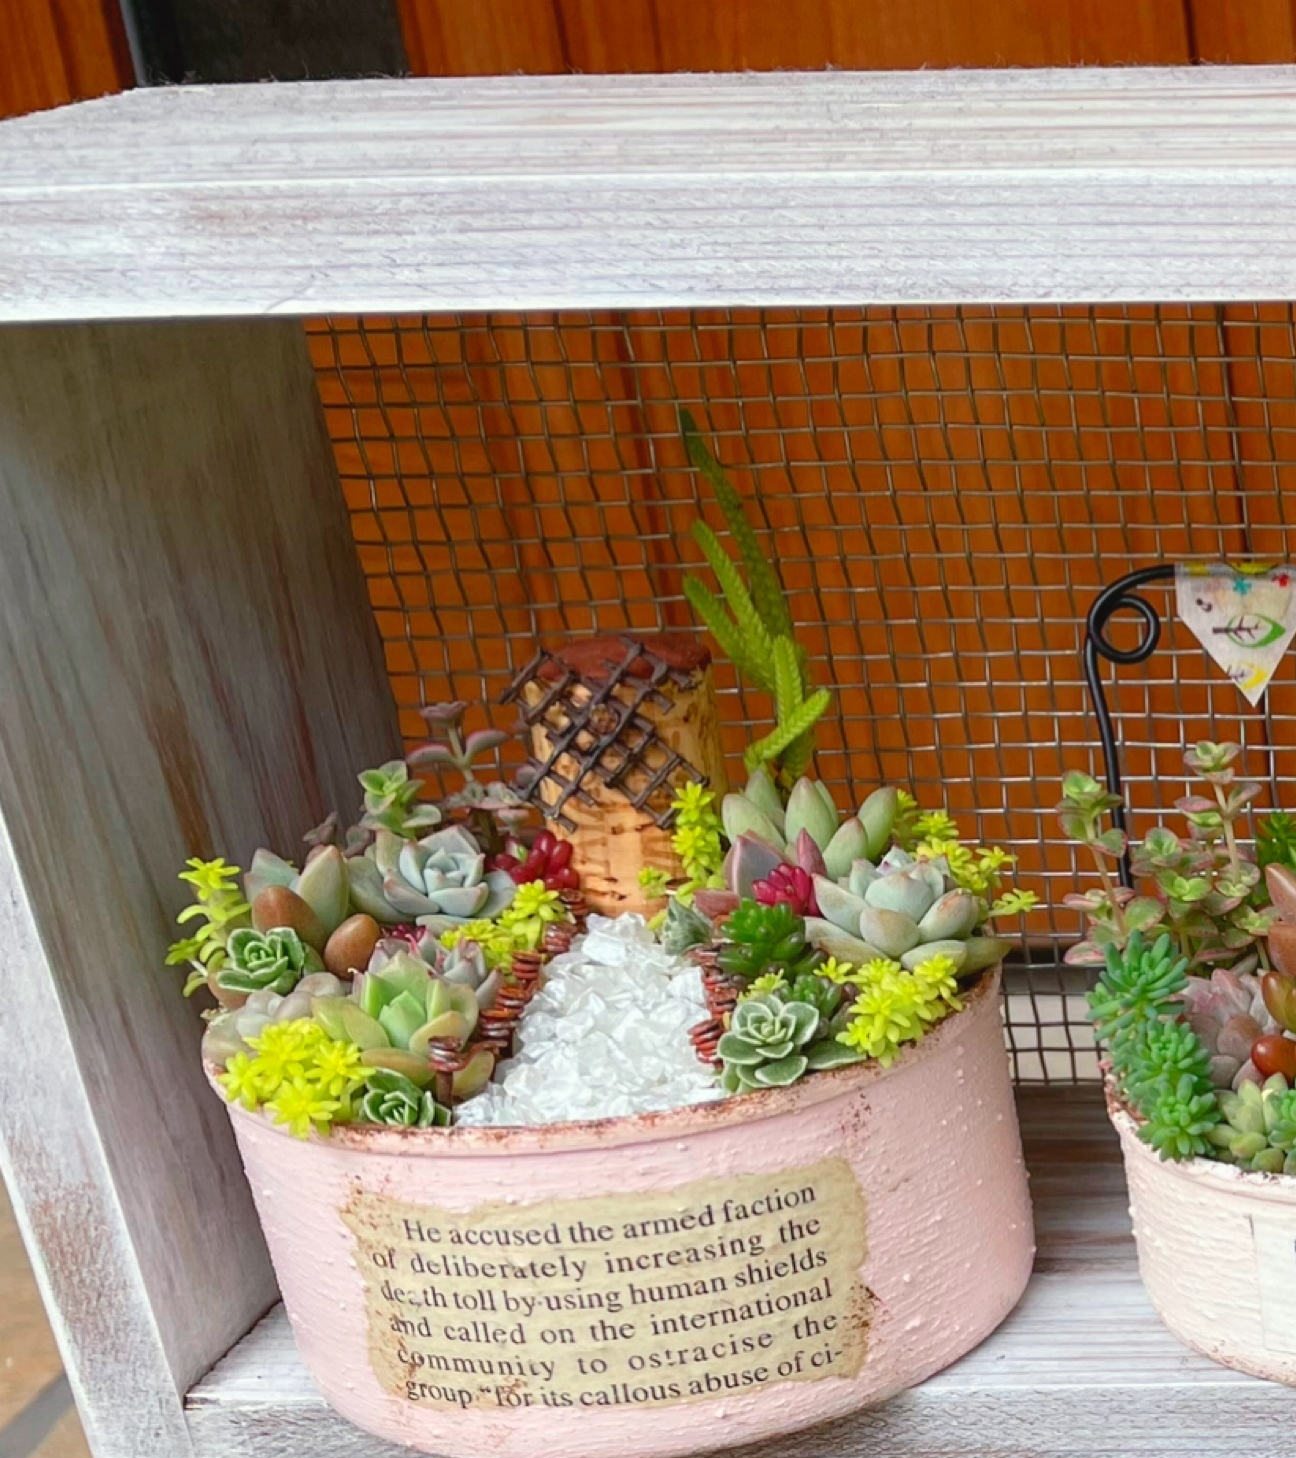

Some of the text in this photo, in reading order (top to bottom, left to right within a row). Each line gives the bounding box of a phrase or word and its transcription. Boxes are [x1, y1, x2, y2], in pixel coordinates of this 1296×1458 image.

[402, 1185, 816, 1246] He accused the armed faction
[373, 1218, 821, 1282] of deliberately increasing the
[453, 1289, 496, 1311] toll
[503, 1290, 536, 1317] by
[545, 1288, 624, 1313] using
[628, 1276, 727, 1305] human
[734, 1248, 828, 1289] shields
[389, 1277, 833, 1345] and called on the international
[397, 1313, 838, 1381] community to ostracise the
[406, 1380, 473, 1409] group
[540, 1386, 573, 1407] its
[579, 1381, 682, 1407] callous
[688, 1366, 769, 1396] abuse
[777, 1350, 805, 1377] of
[810, 1342, 844, 1368] ci-
